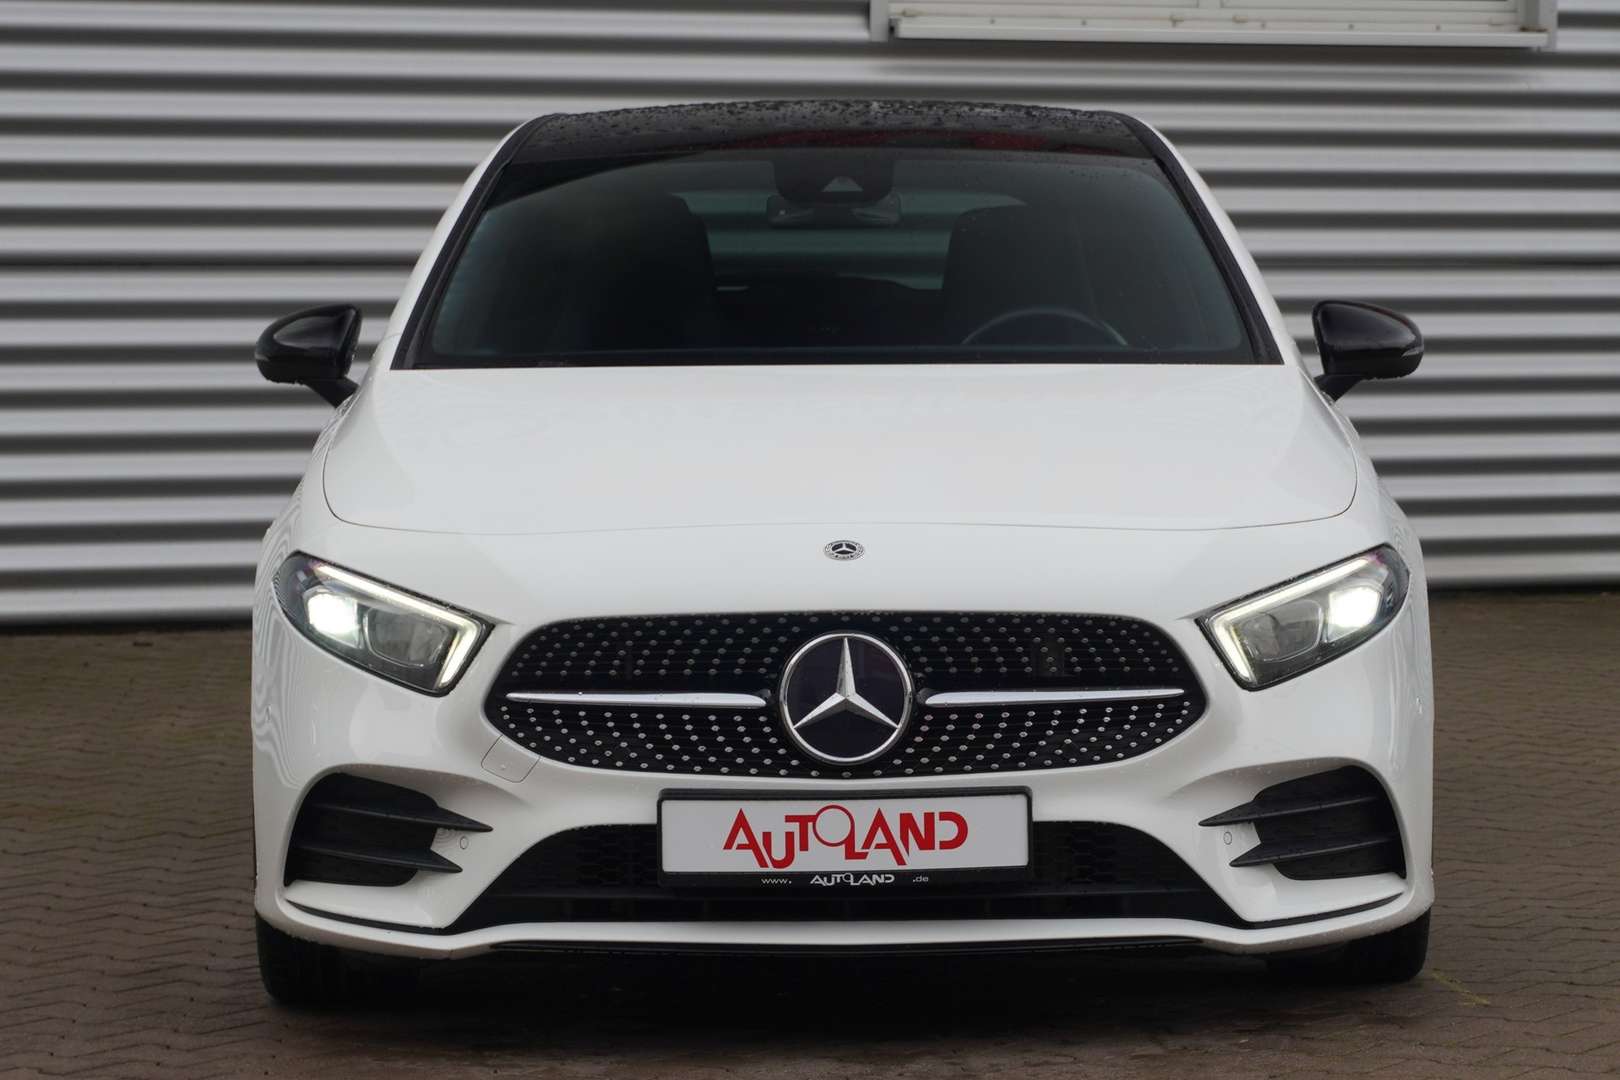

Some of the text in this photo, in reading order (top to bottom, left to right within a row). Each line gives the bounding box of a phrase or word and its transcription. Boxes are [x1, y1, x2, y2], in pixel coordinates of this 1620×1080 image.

[723, 805, 968, 869] AUTOLAND
[810, 873, 895, 886] AUTOLAND
[912, 875, 929, 883] .de
